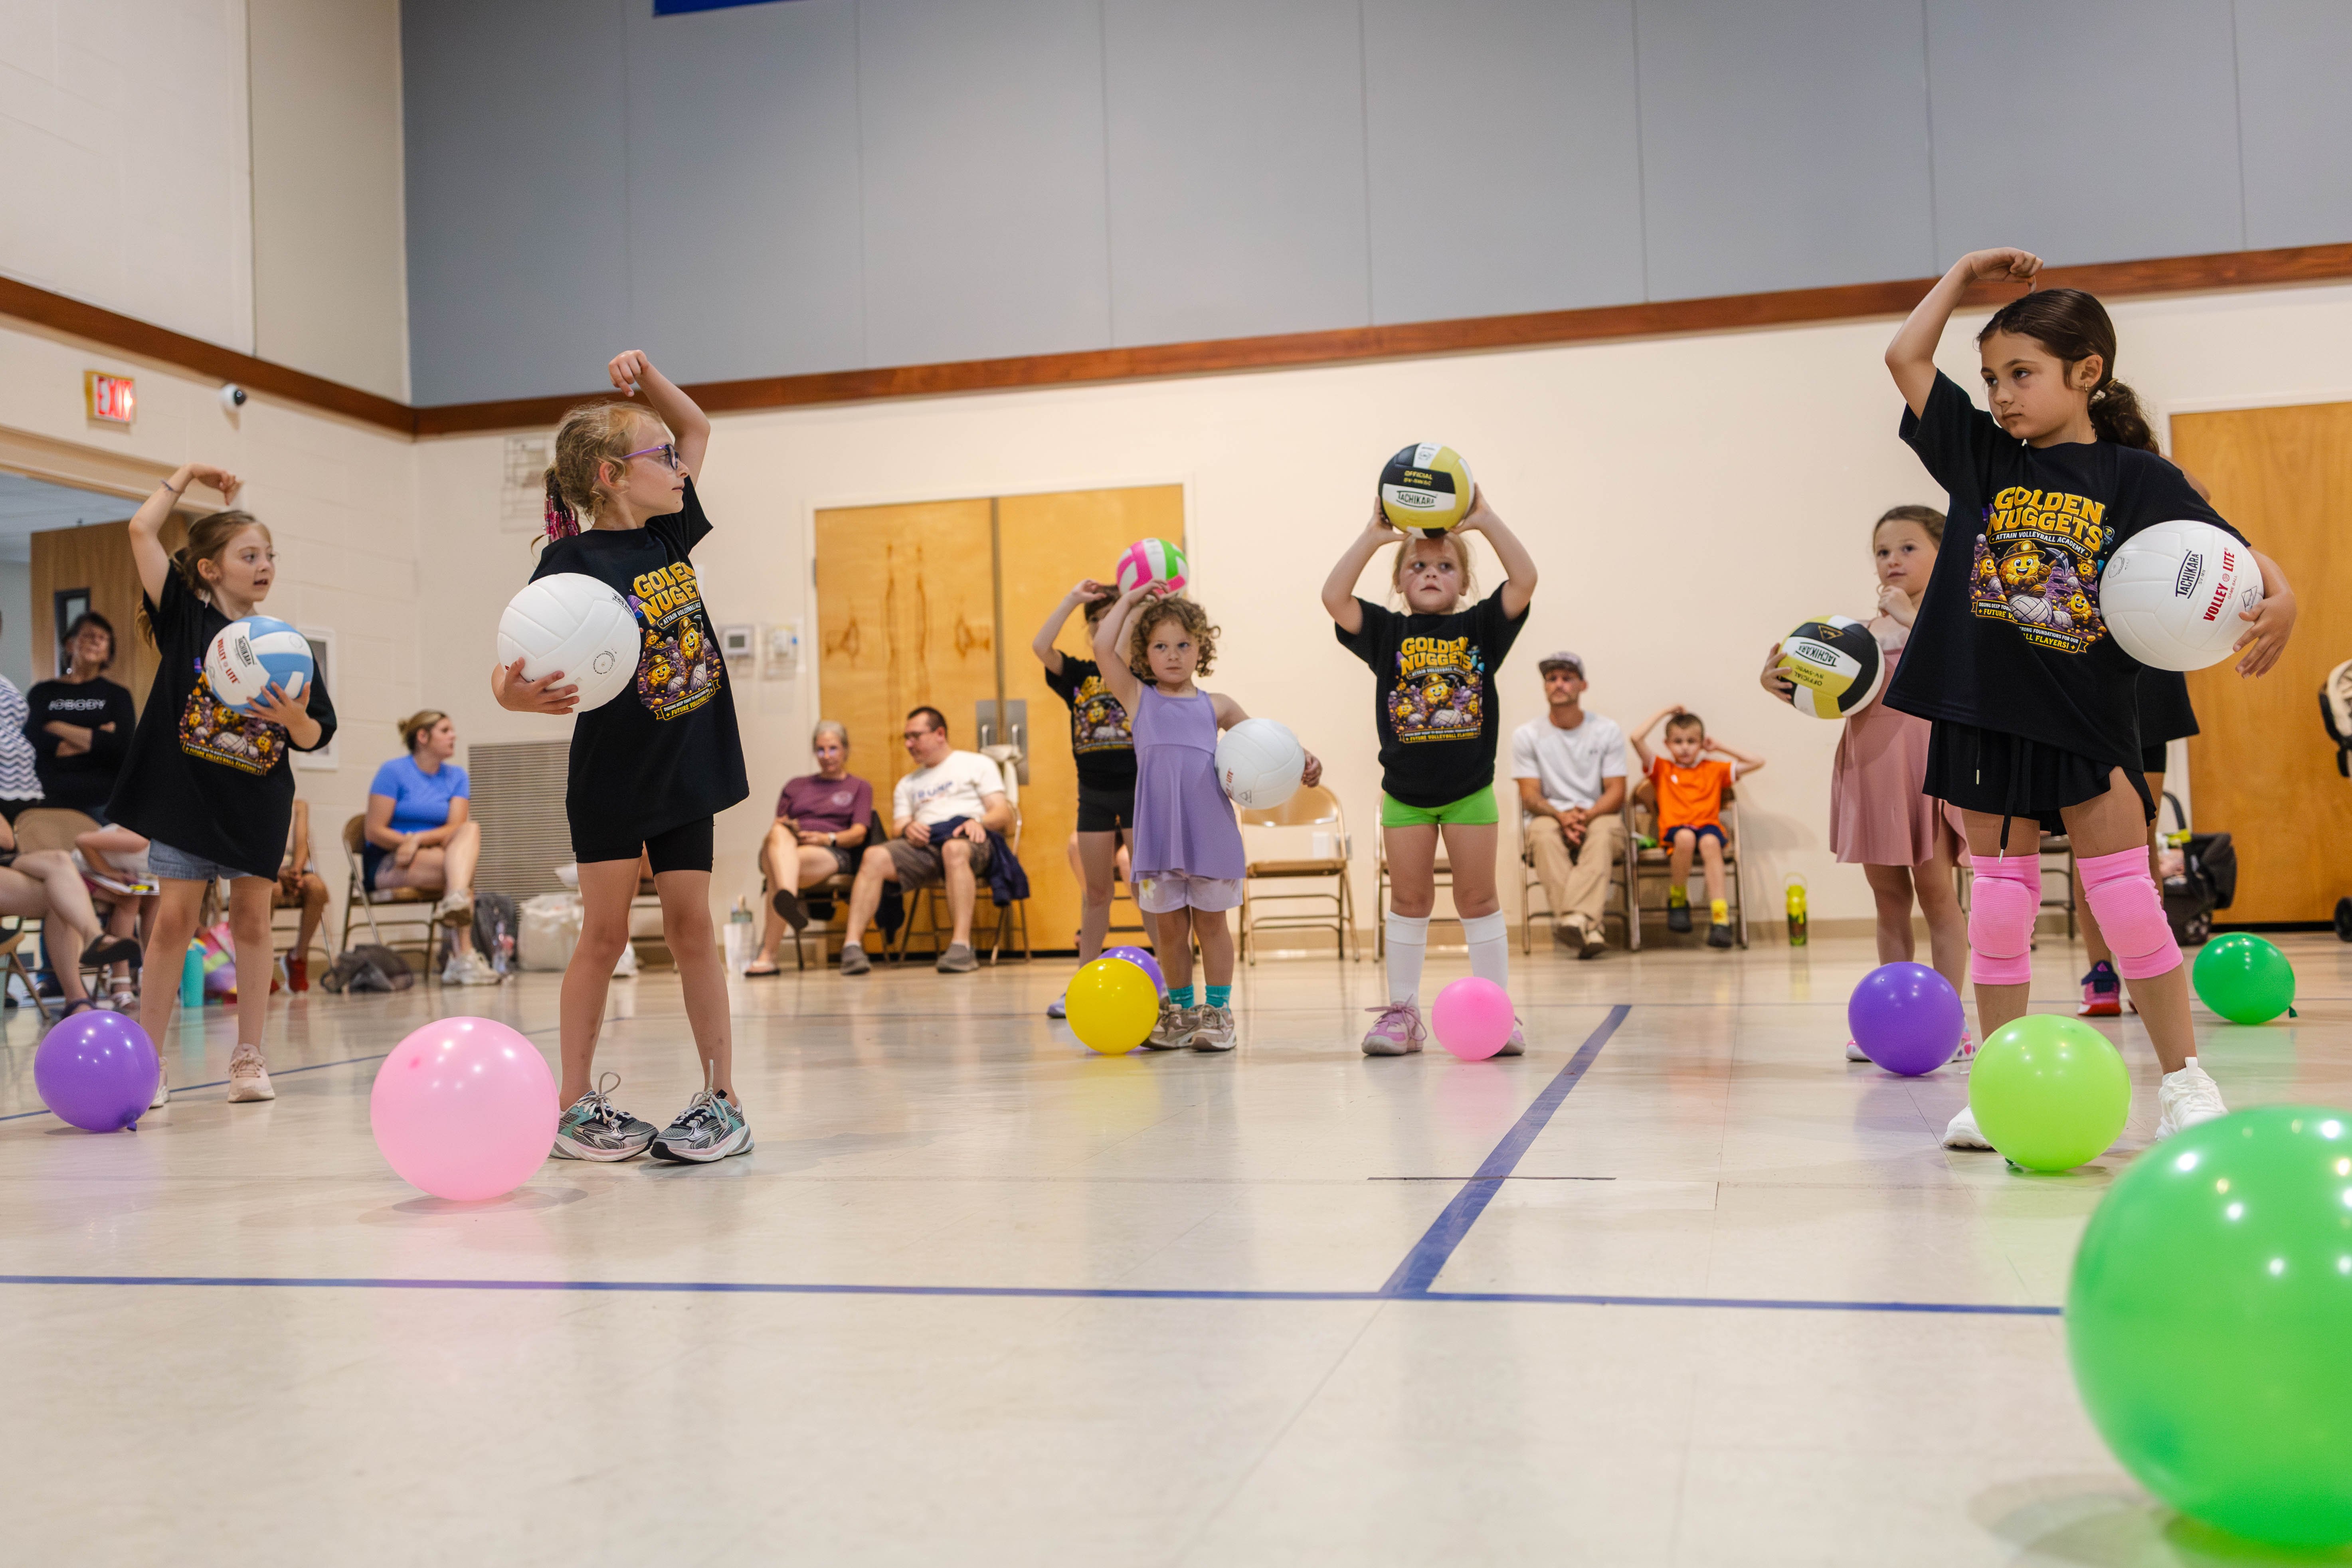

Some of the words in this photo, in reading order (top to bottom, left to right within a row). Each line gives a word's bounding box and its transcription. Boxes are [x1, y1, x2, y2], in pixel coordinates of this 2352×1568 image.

[97, 376, 133, 421] EXIT
[1397, 491, 1434, 504] TACHIKARA
[1994, 486, 2105, 525] GOLDEN
[1986, 507, 2103, 552] NUGGETS
[2019, 531, 2055, 542] VOLLEYBALL
[2057, 536, 2085, 554] ACADEMY
[2176, 554, 2199, 597] TACHIKARA
[2203, 583, 2228, 621] VOLLEY
[2223, 551, 2235, 572] LITE
[663, 612, 678, 625] ATTAIN
[1984, 609, 2006, 618] FUTURE
[2033, 629, 2061, 639] FOUNDATIONS
[1799, 646, 1837, 666] TACHIKARA
[1794, 670, 1822, 686] OFFICIAL
[671, 704, 689, 716] FUTURE
